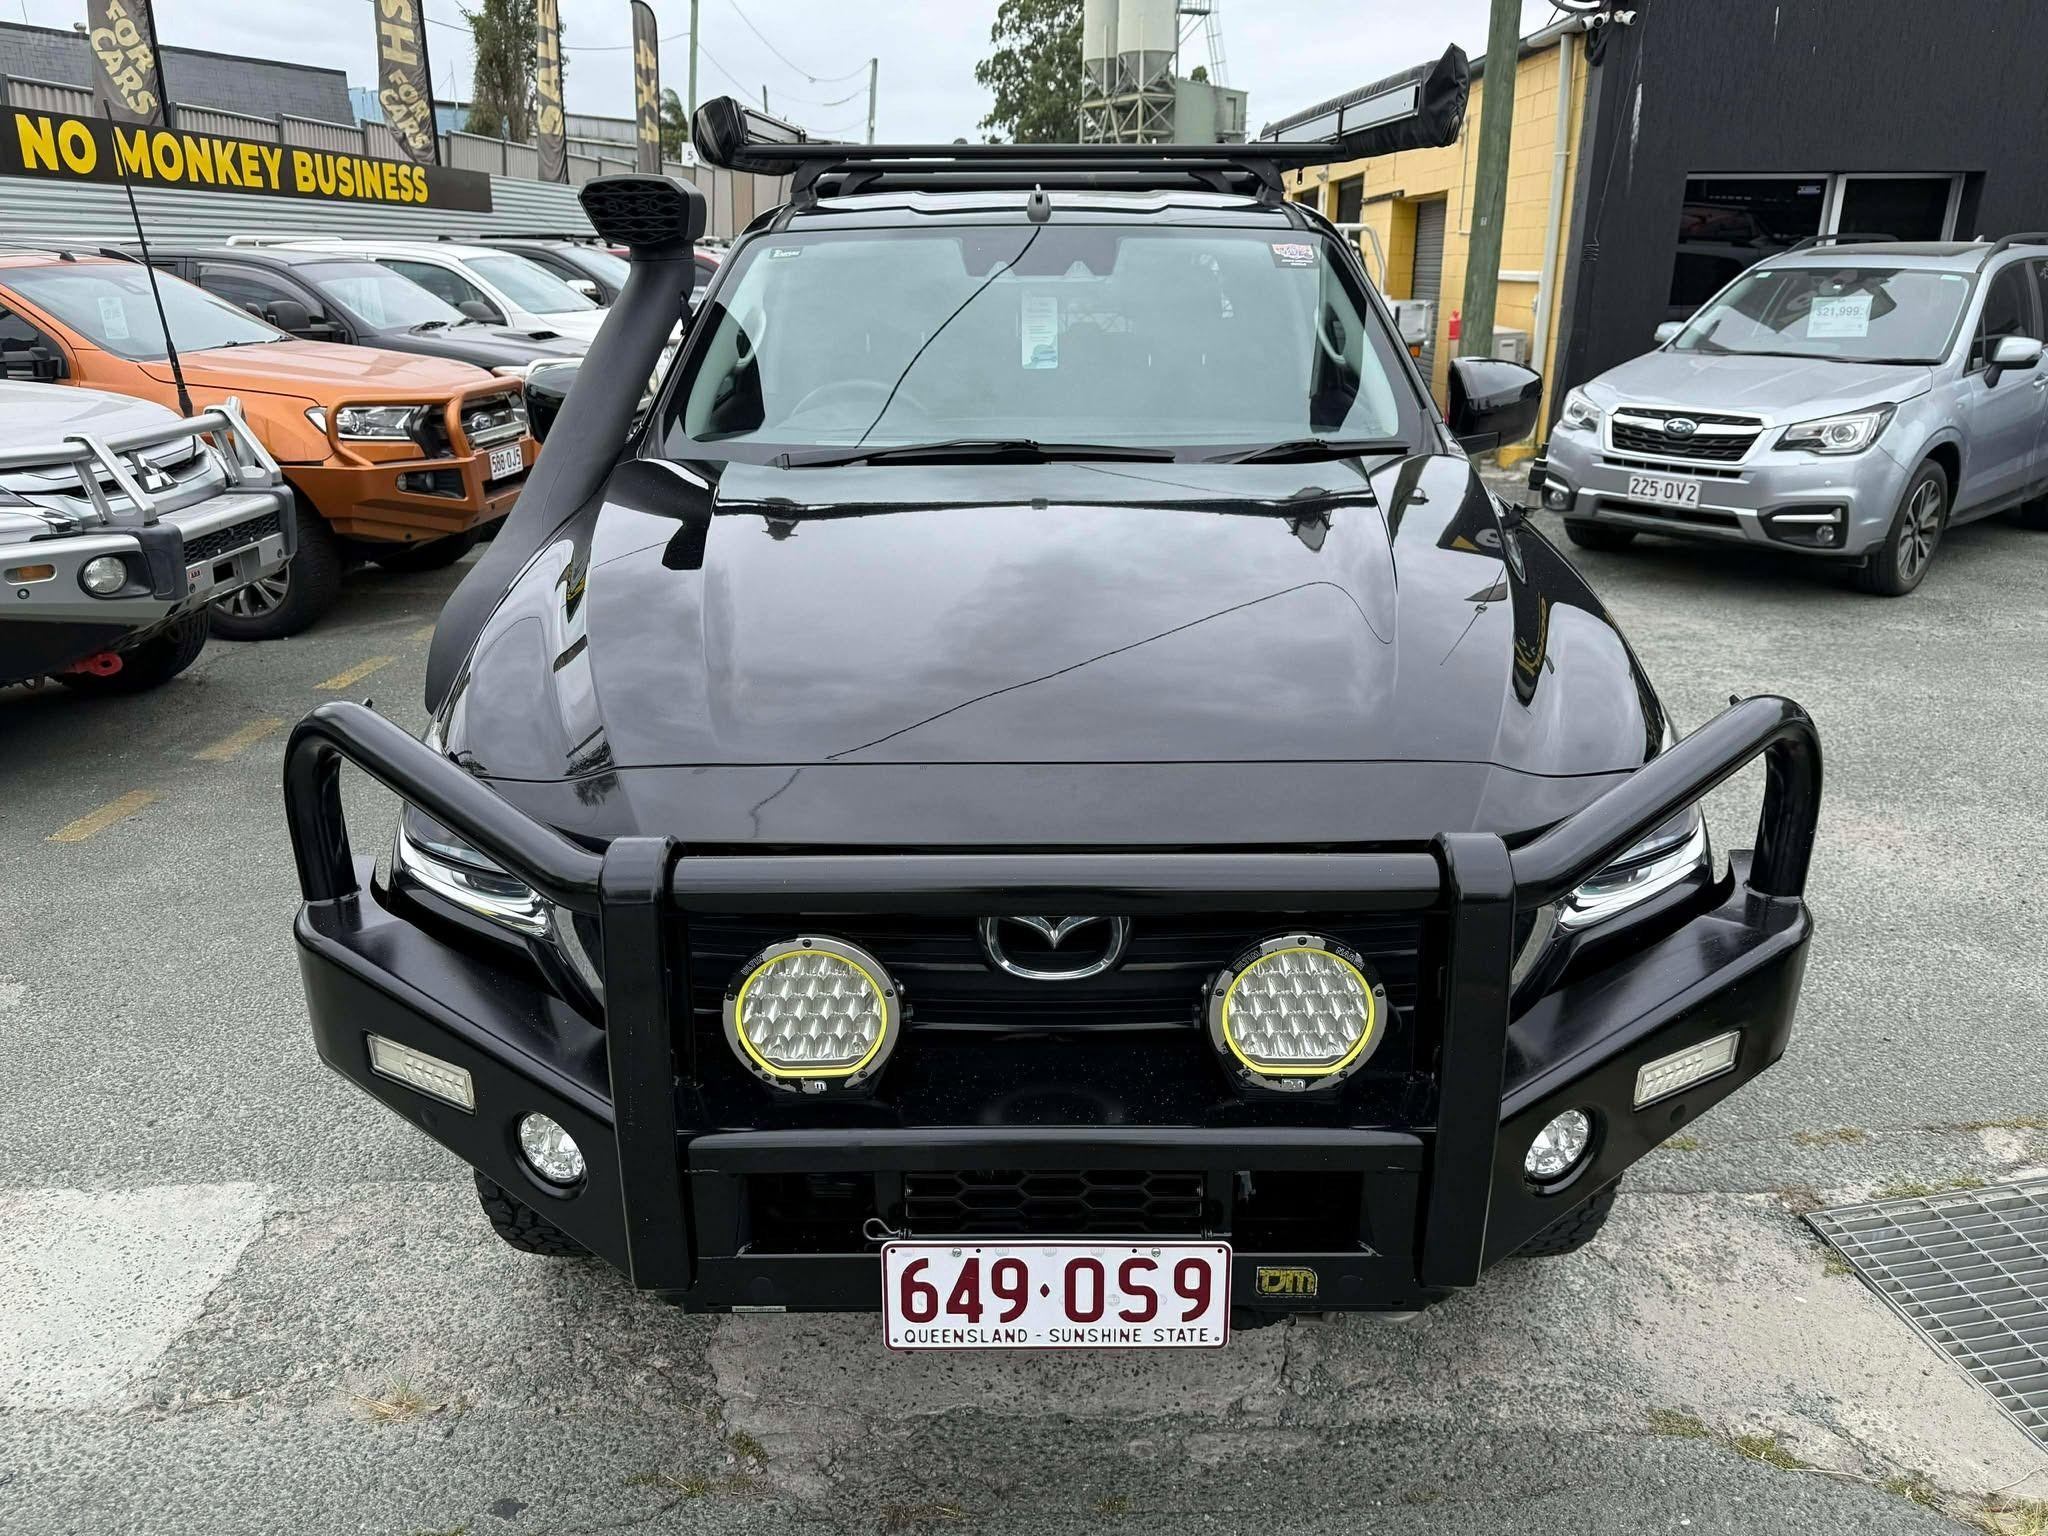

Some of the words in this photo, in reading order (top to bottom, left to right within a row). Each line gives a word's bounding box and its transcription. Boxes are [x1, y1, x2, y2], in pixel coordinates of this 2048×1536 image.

[106, 0, 155, 74] FOR
[91, 28, 157, 115] CARS
[388, 69, 430, 121] FOR
[379, 88, 430, 149] CARS
[14, 112, 98, 174] NO
[113, 126, 282, 190] MONKEY
[293, 150, 429, 203] BUSINESS
[904, 1328, 1028, 1344] QUEENSLAND
[1049, 1328, 1142, 1343] SUNSHINE
[1153, 1327, 1209, 1342] STATE
